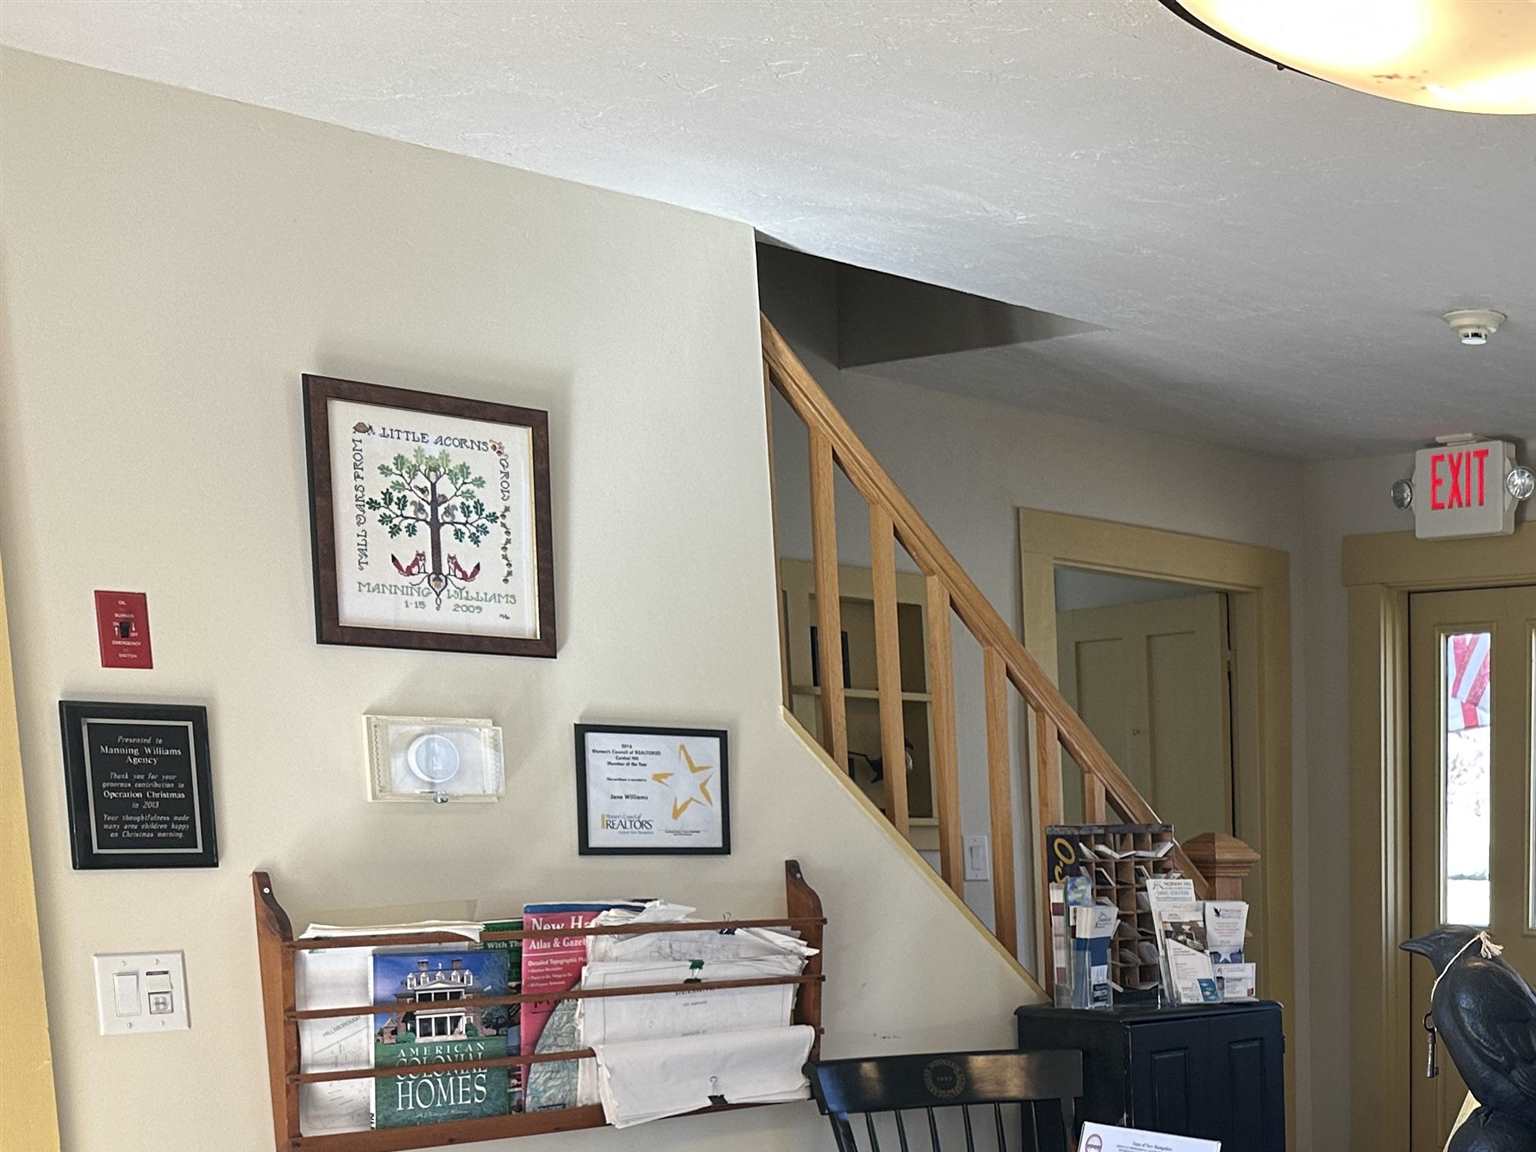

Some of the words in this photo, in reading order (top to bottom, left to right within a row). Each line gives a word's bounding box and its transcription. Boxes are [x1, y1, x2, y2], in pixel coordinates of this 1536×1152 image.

[380, 427, 429, 444] LITTLE
[434, 435, 489, 452] ACORNS
[1431, 448, 1489, 511] EXIT
[358, 581, 432, 598] MANNING
[447, 588, 517, 604] WILLIAMS
[452, 603, 482, 614] 2009
[100, 745, 140, 756] Manning
[144, 746, 182, 756] Williams
[126, 756, 158, 766] Agency
[103, 790, 143, 799] Operation
[146, 791, 186, 799] Christmas
[528, 938, 551, 950] Atlas
[397, 1042, 485, 1058] AMERICAN
[396, 1073, 488, 1112] HOMES
